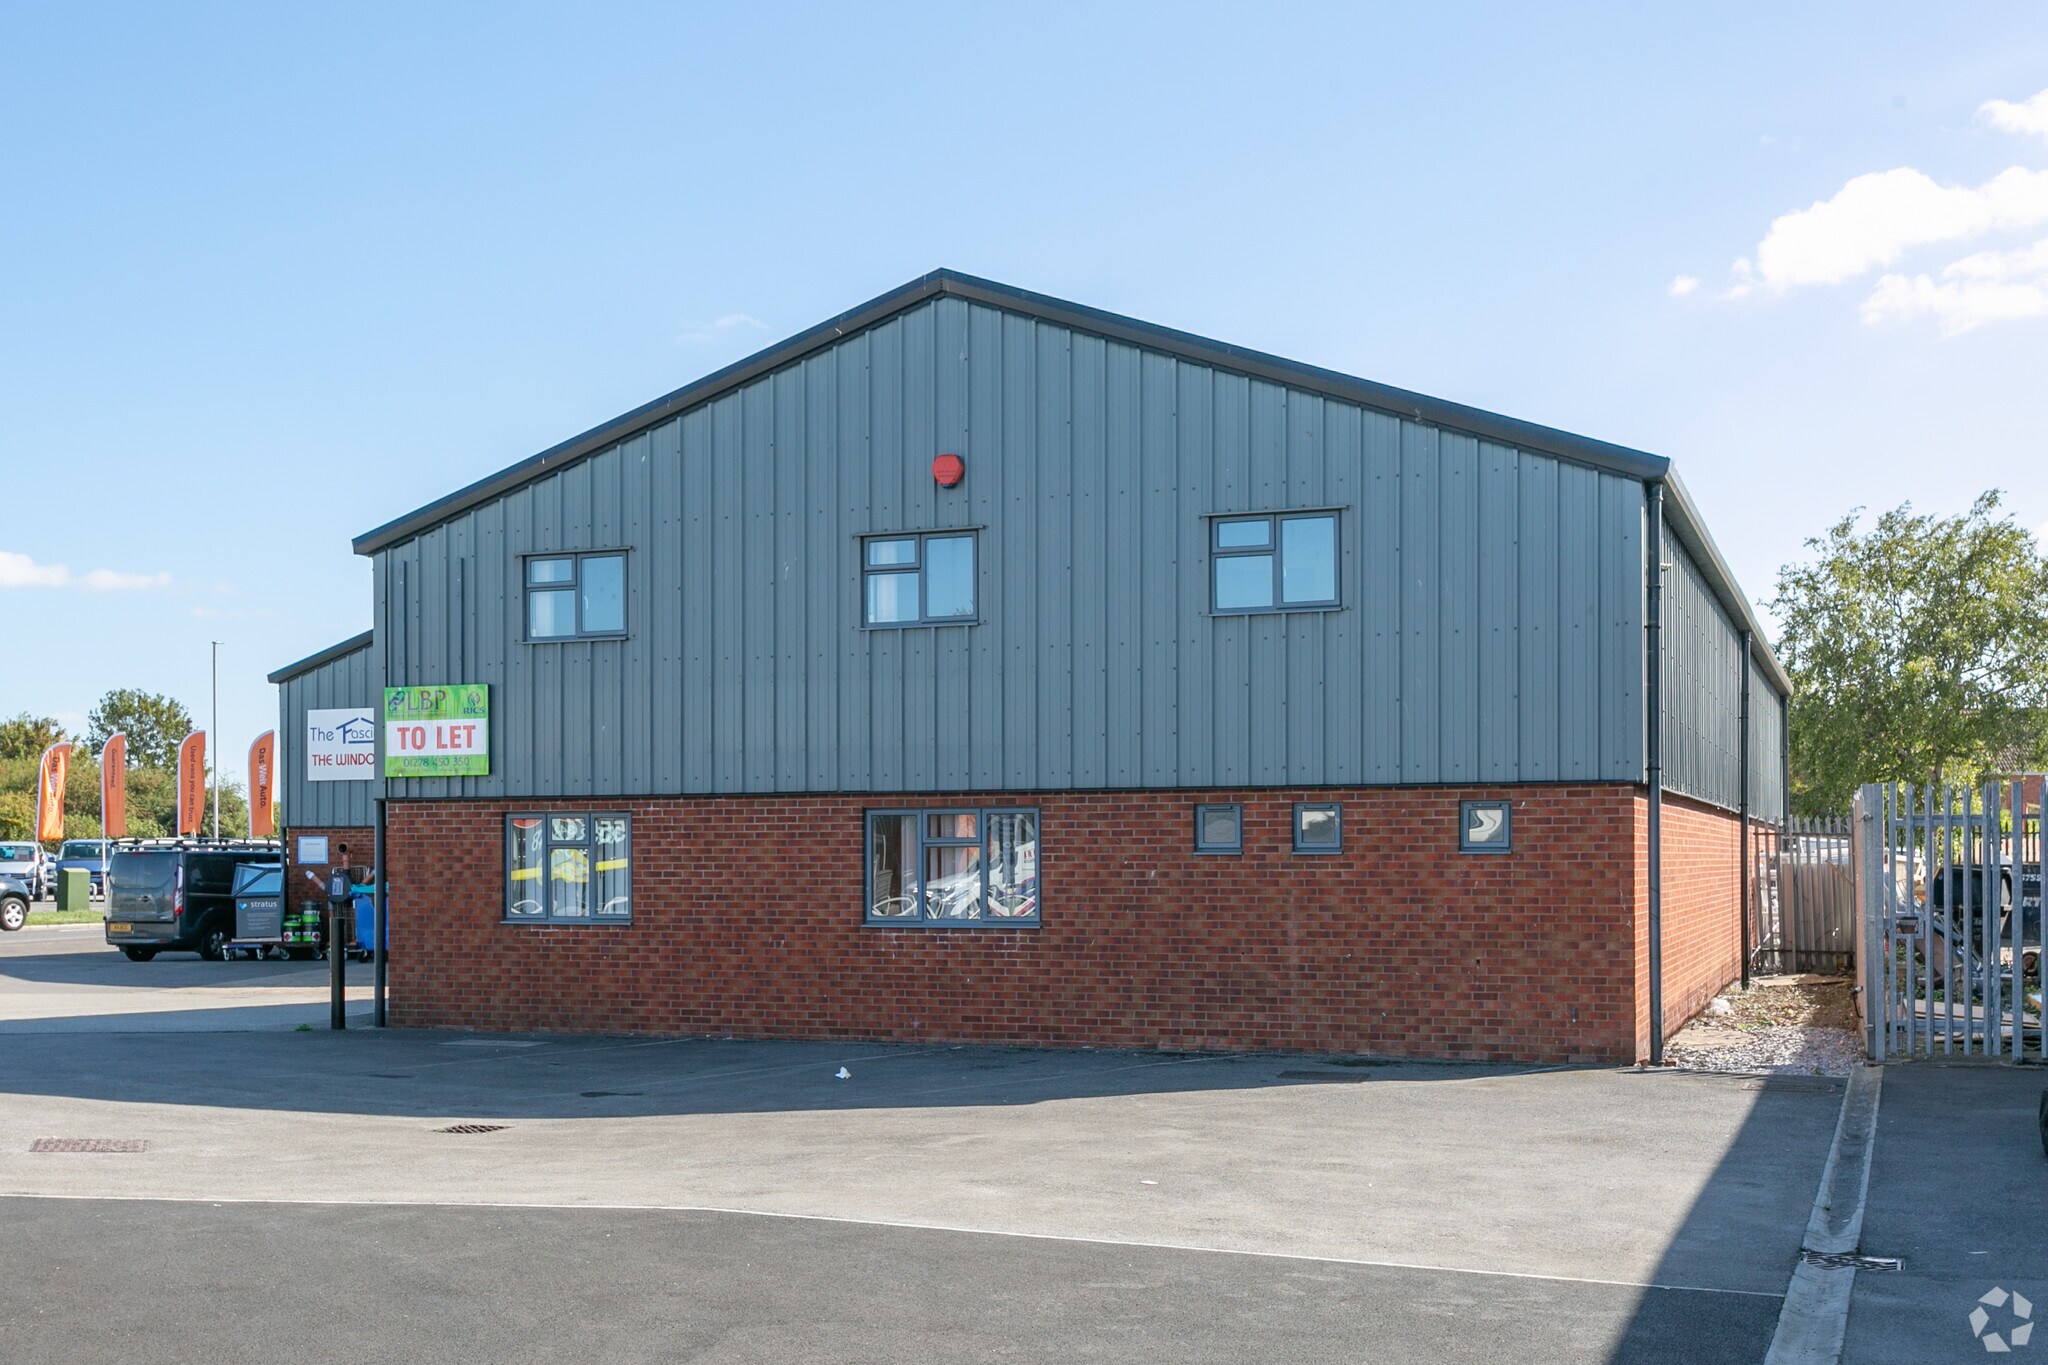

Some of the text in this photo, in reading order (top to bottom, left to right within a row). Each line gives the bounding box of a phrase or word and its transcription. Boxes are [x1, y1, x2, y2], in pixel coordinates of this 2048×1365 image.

[407, 689, 446, 711] LBP
[310, 717, 373, 744] The Fasci
[397, 725, 476, 750] TO LET
[312, 753, 374, 767] THE WINDO
[403, 758, 430, 768] 01278
[453, 757, 470, 767] 350
